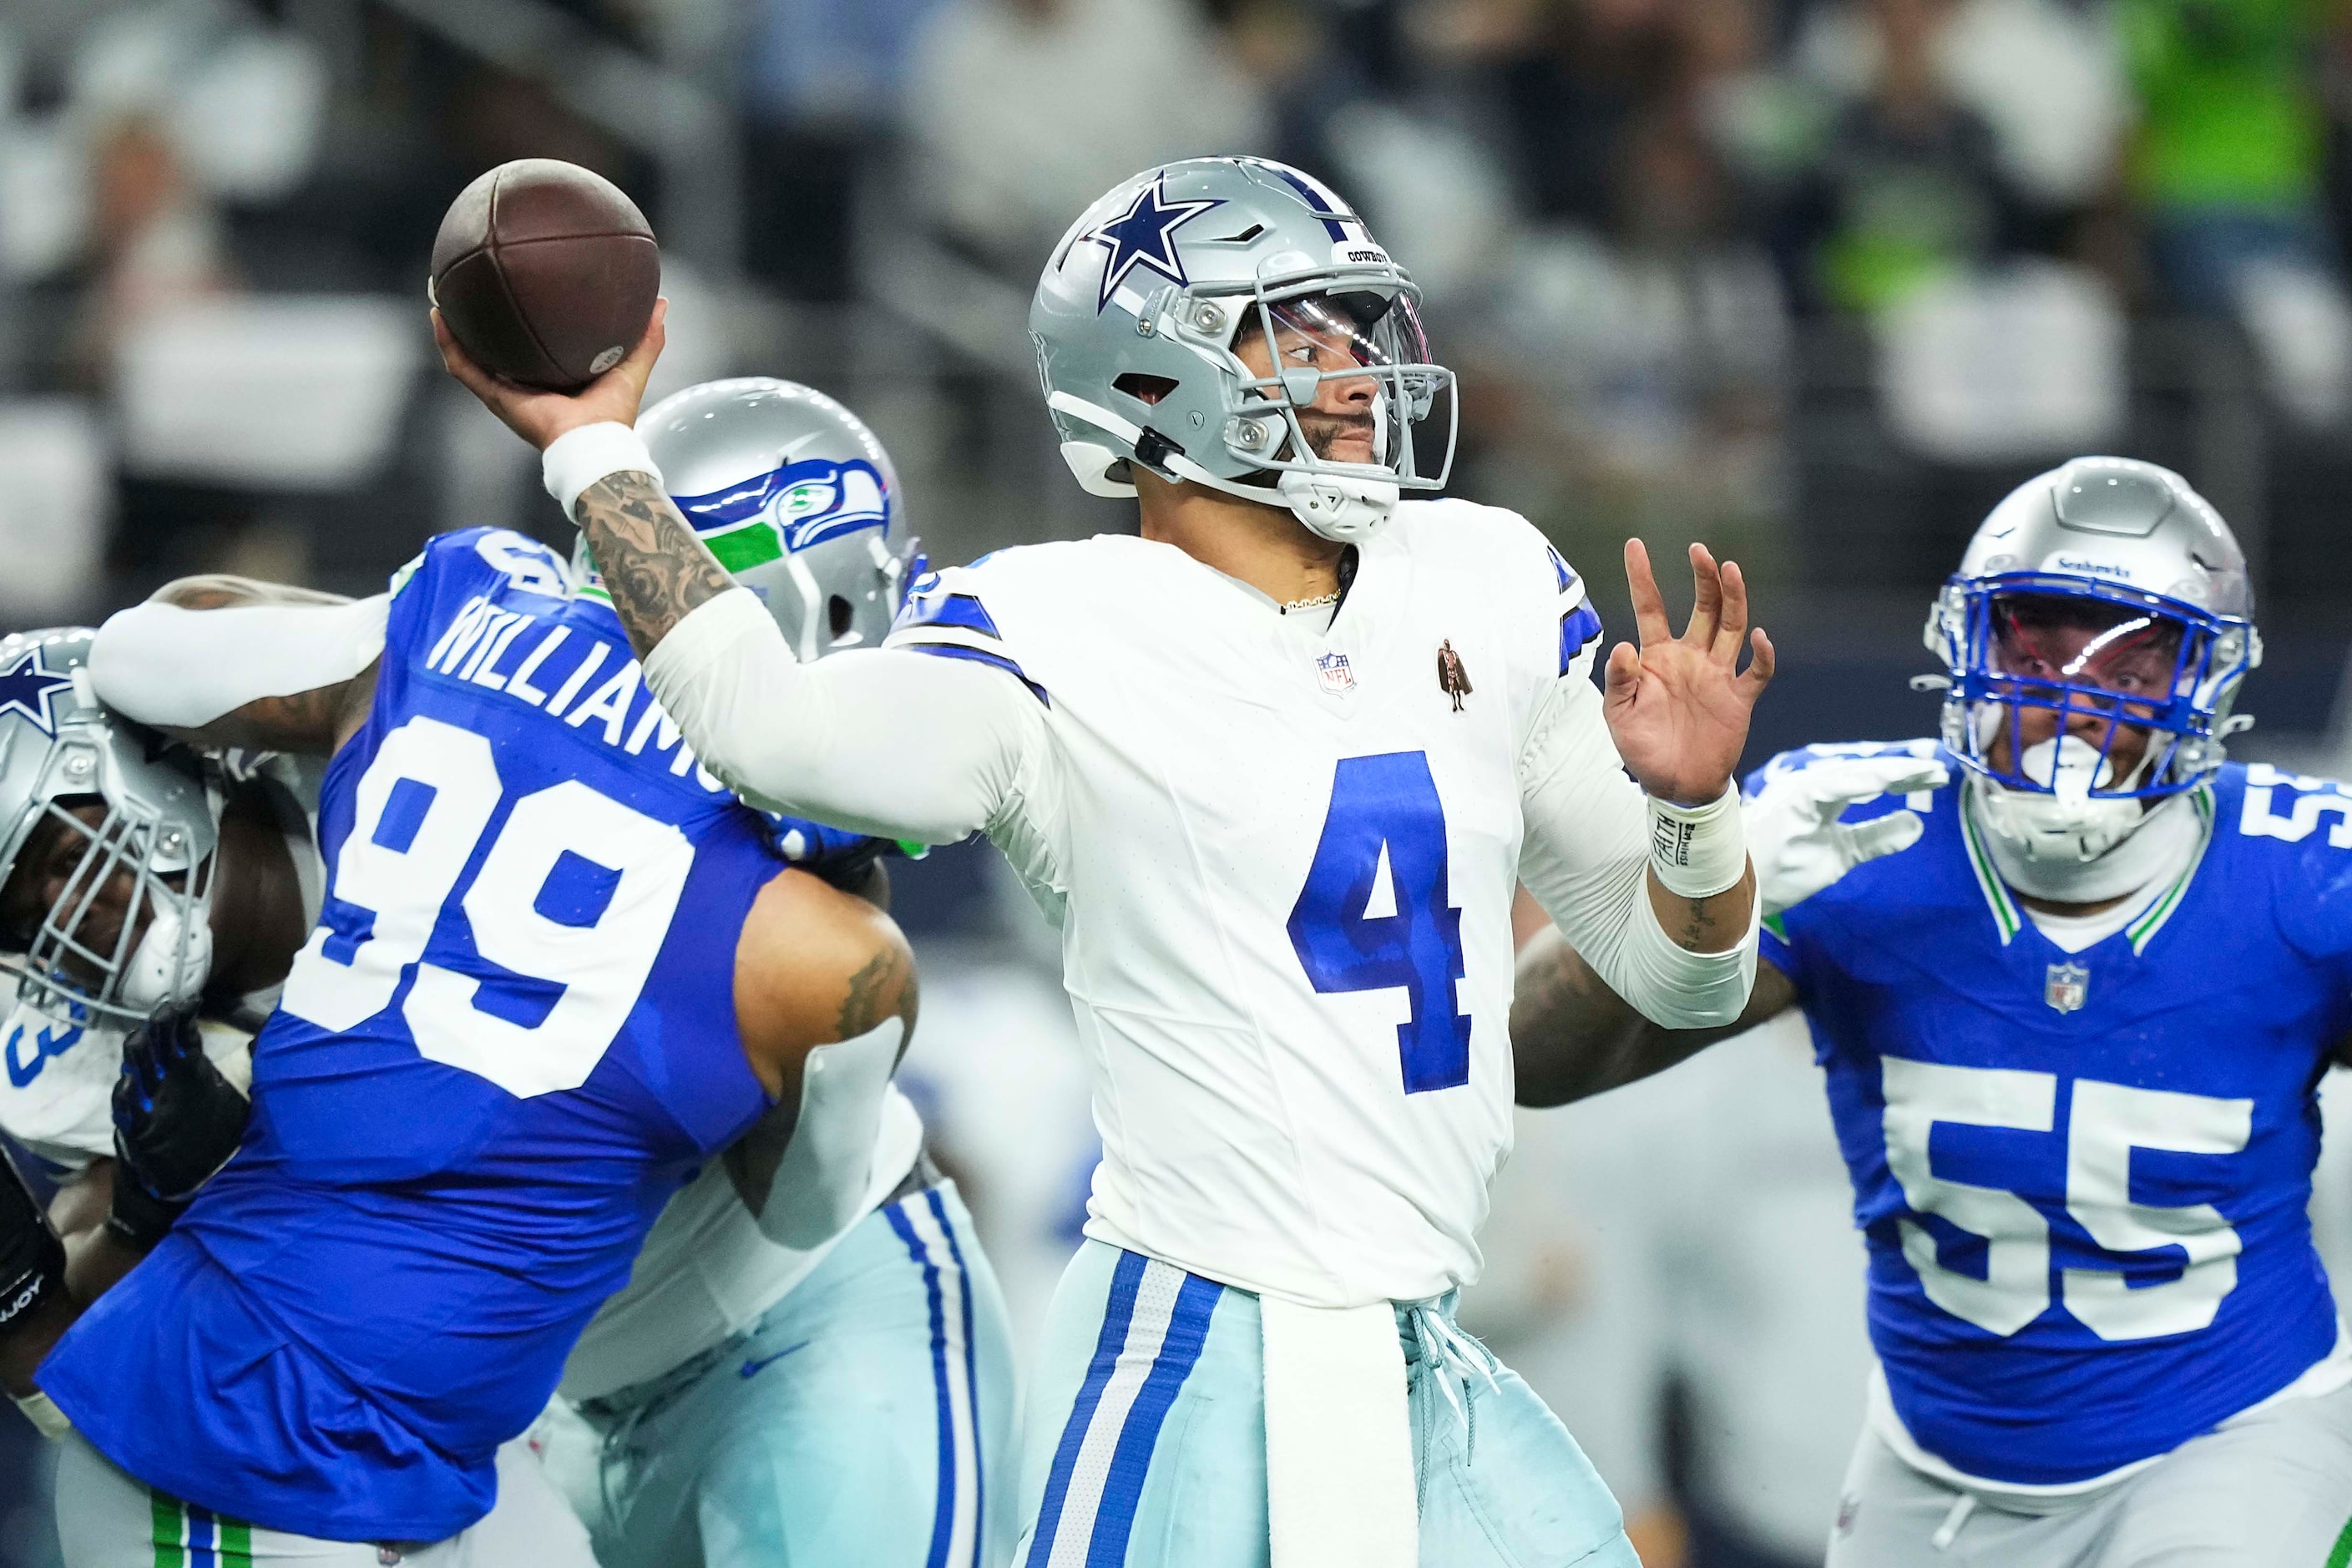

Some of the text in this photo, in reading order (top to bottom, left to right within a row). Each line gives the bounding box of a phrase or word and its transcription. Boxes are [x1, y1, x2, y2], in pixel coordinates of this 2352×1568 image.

[1324, 668, 1352, 685] NFL
[281, 716, 695, 1099] 99
[1287, 751, 1471, 1095] 4
[1652, 811, 1677, 867] FAITH
[1880, 1055, 2253, 1341] 55
